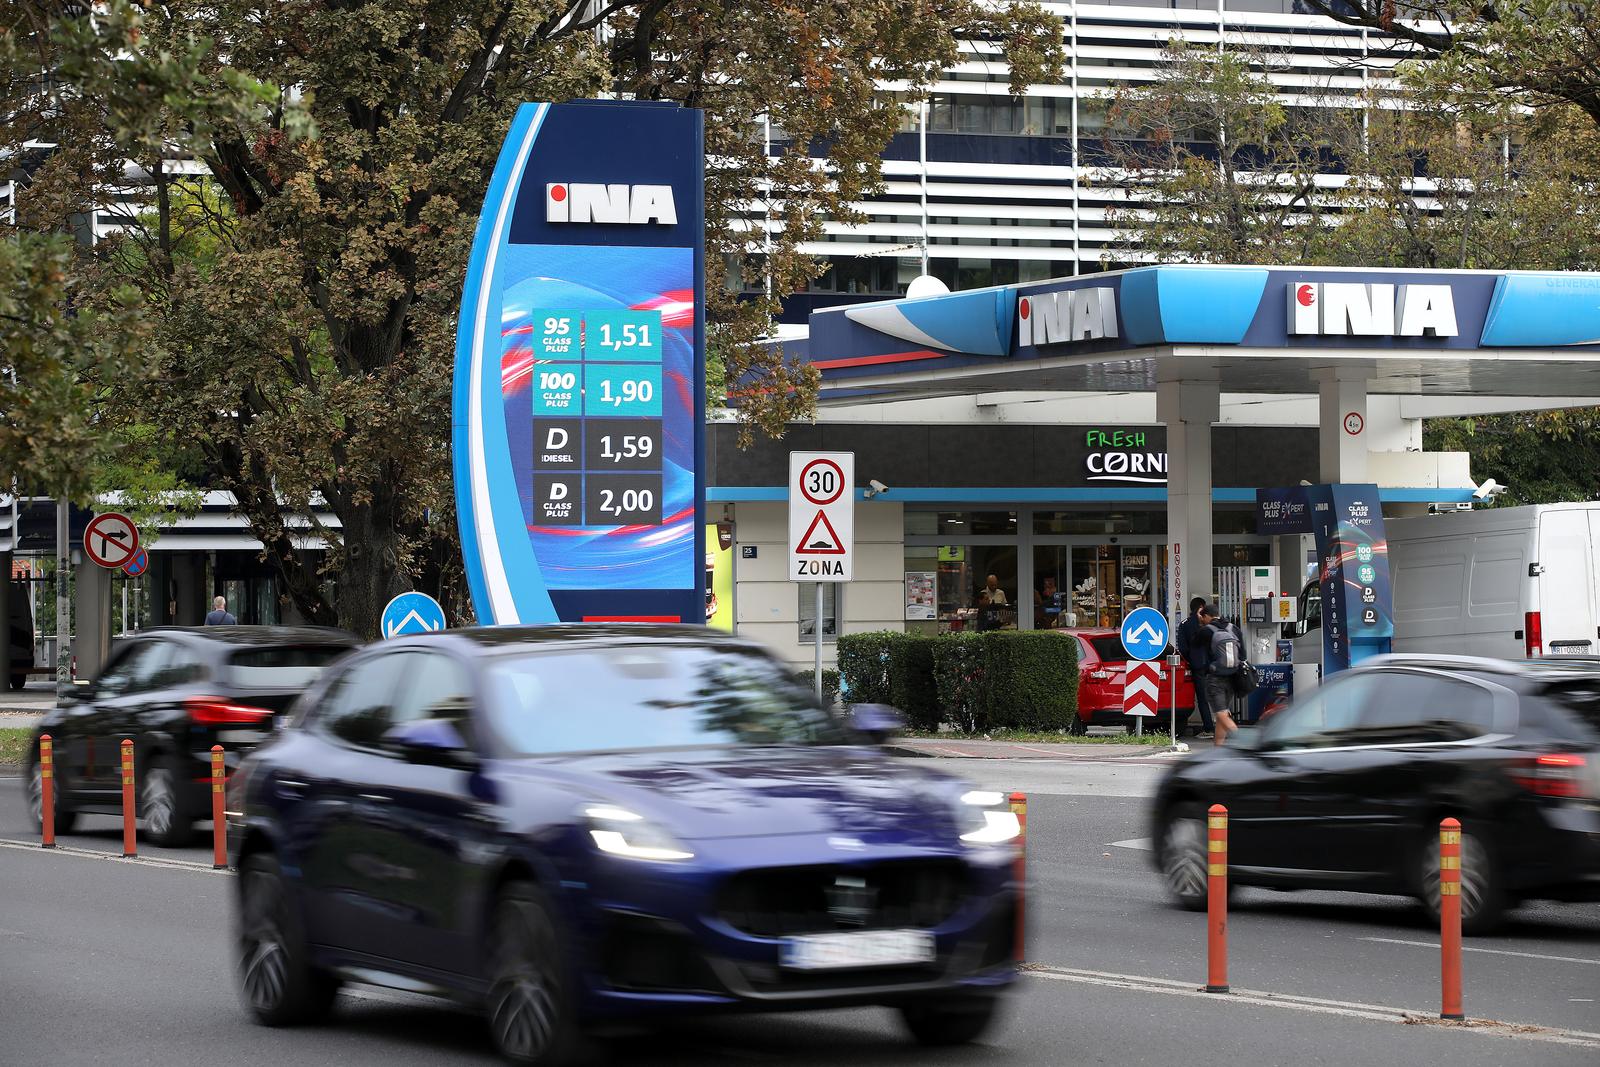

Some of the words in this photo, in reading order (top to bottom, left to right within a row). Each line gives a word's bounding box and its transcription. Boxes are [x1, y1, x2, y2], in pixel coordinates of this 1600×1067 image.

[544, 318, 570, 335] 95
[542, 337, 571, 345] CLASS
[600, 324, 652, 351] 1,51
[545, 345, 569, 353] PLUS
[540, 373, 575, 390] 100
[542, 392, 571, 400] CLASS
[600, 380, 652, 407] 1,90
[546, 400, 569, 408] PLUS
[546, 428, 568, 450] D
[1086, 430, 1145, 447] FRESH
[600, 436, 653, 462] 1,59
[543, 454, 573, 463] DIESEL
[1086, 452, 1168, 473] CORN
[808, 471, 834, 494] 30
[550, 483, 567, 500] D
[543, 502, 572, 510] CLASS
[600, 489, 653, 516] 2,00
[1263, 501, 1280, 510] CLASS
[546, 510, 569, 518] PLUS
[1264, 510, 1279, 518] PLUS
[1324, 525, 1328, 536] 1
[1357, 546, 1371, 554] 100
[797, 560, 845, 576] ZONA
[1361, 567, 1371, 576] 95
[1365, 587, 1372, 595] D
[1366, 610, 1374, 619] D
